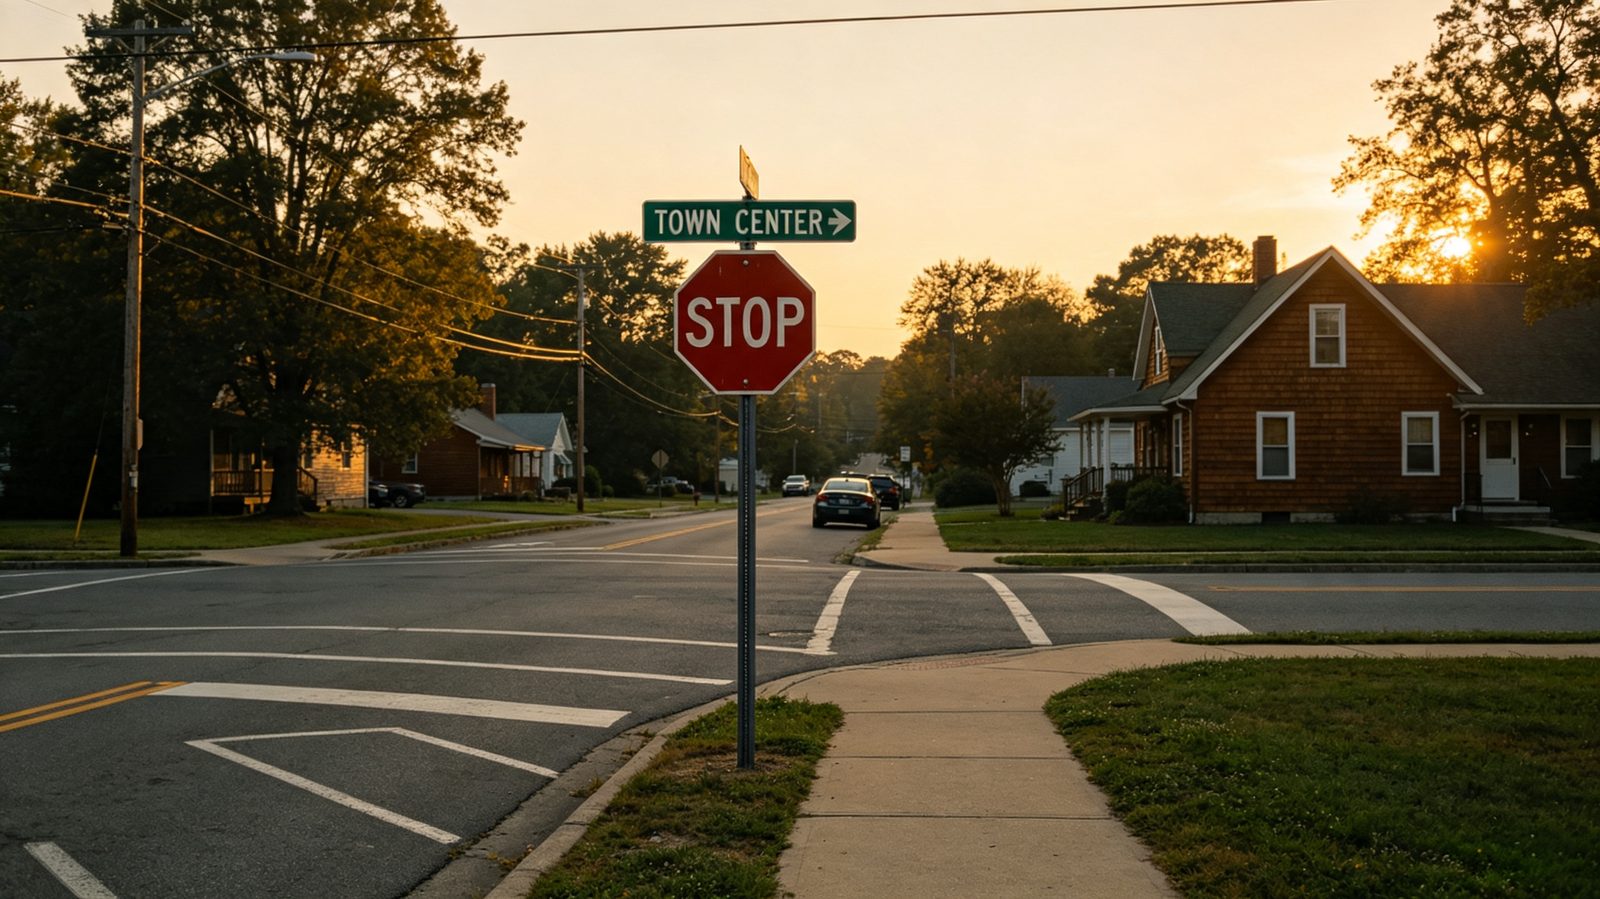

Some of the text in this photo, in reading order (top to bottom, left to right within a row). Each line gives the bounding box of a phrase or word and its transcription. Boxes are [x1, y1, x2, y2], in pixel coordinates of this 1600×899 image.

[654, 209, 823, 235] TOWN CENTER
[685, 296, 805, 348] STOP
